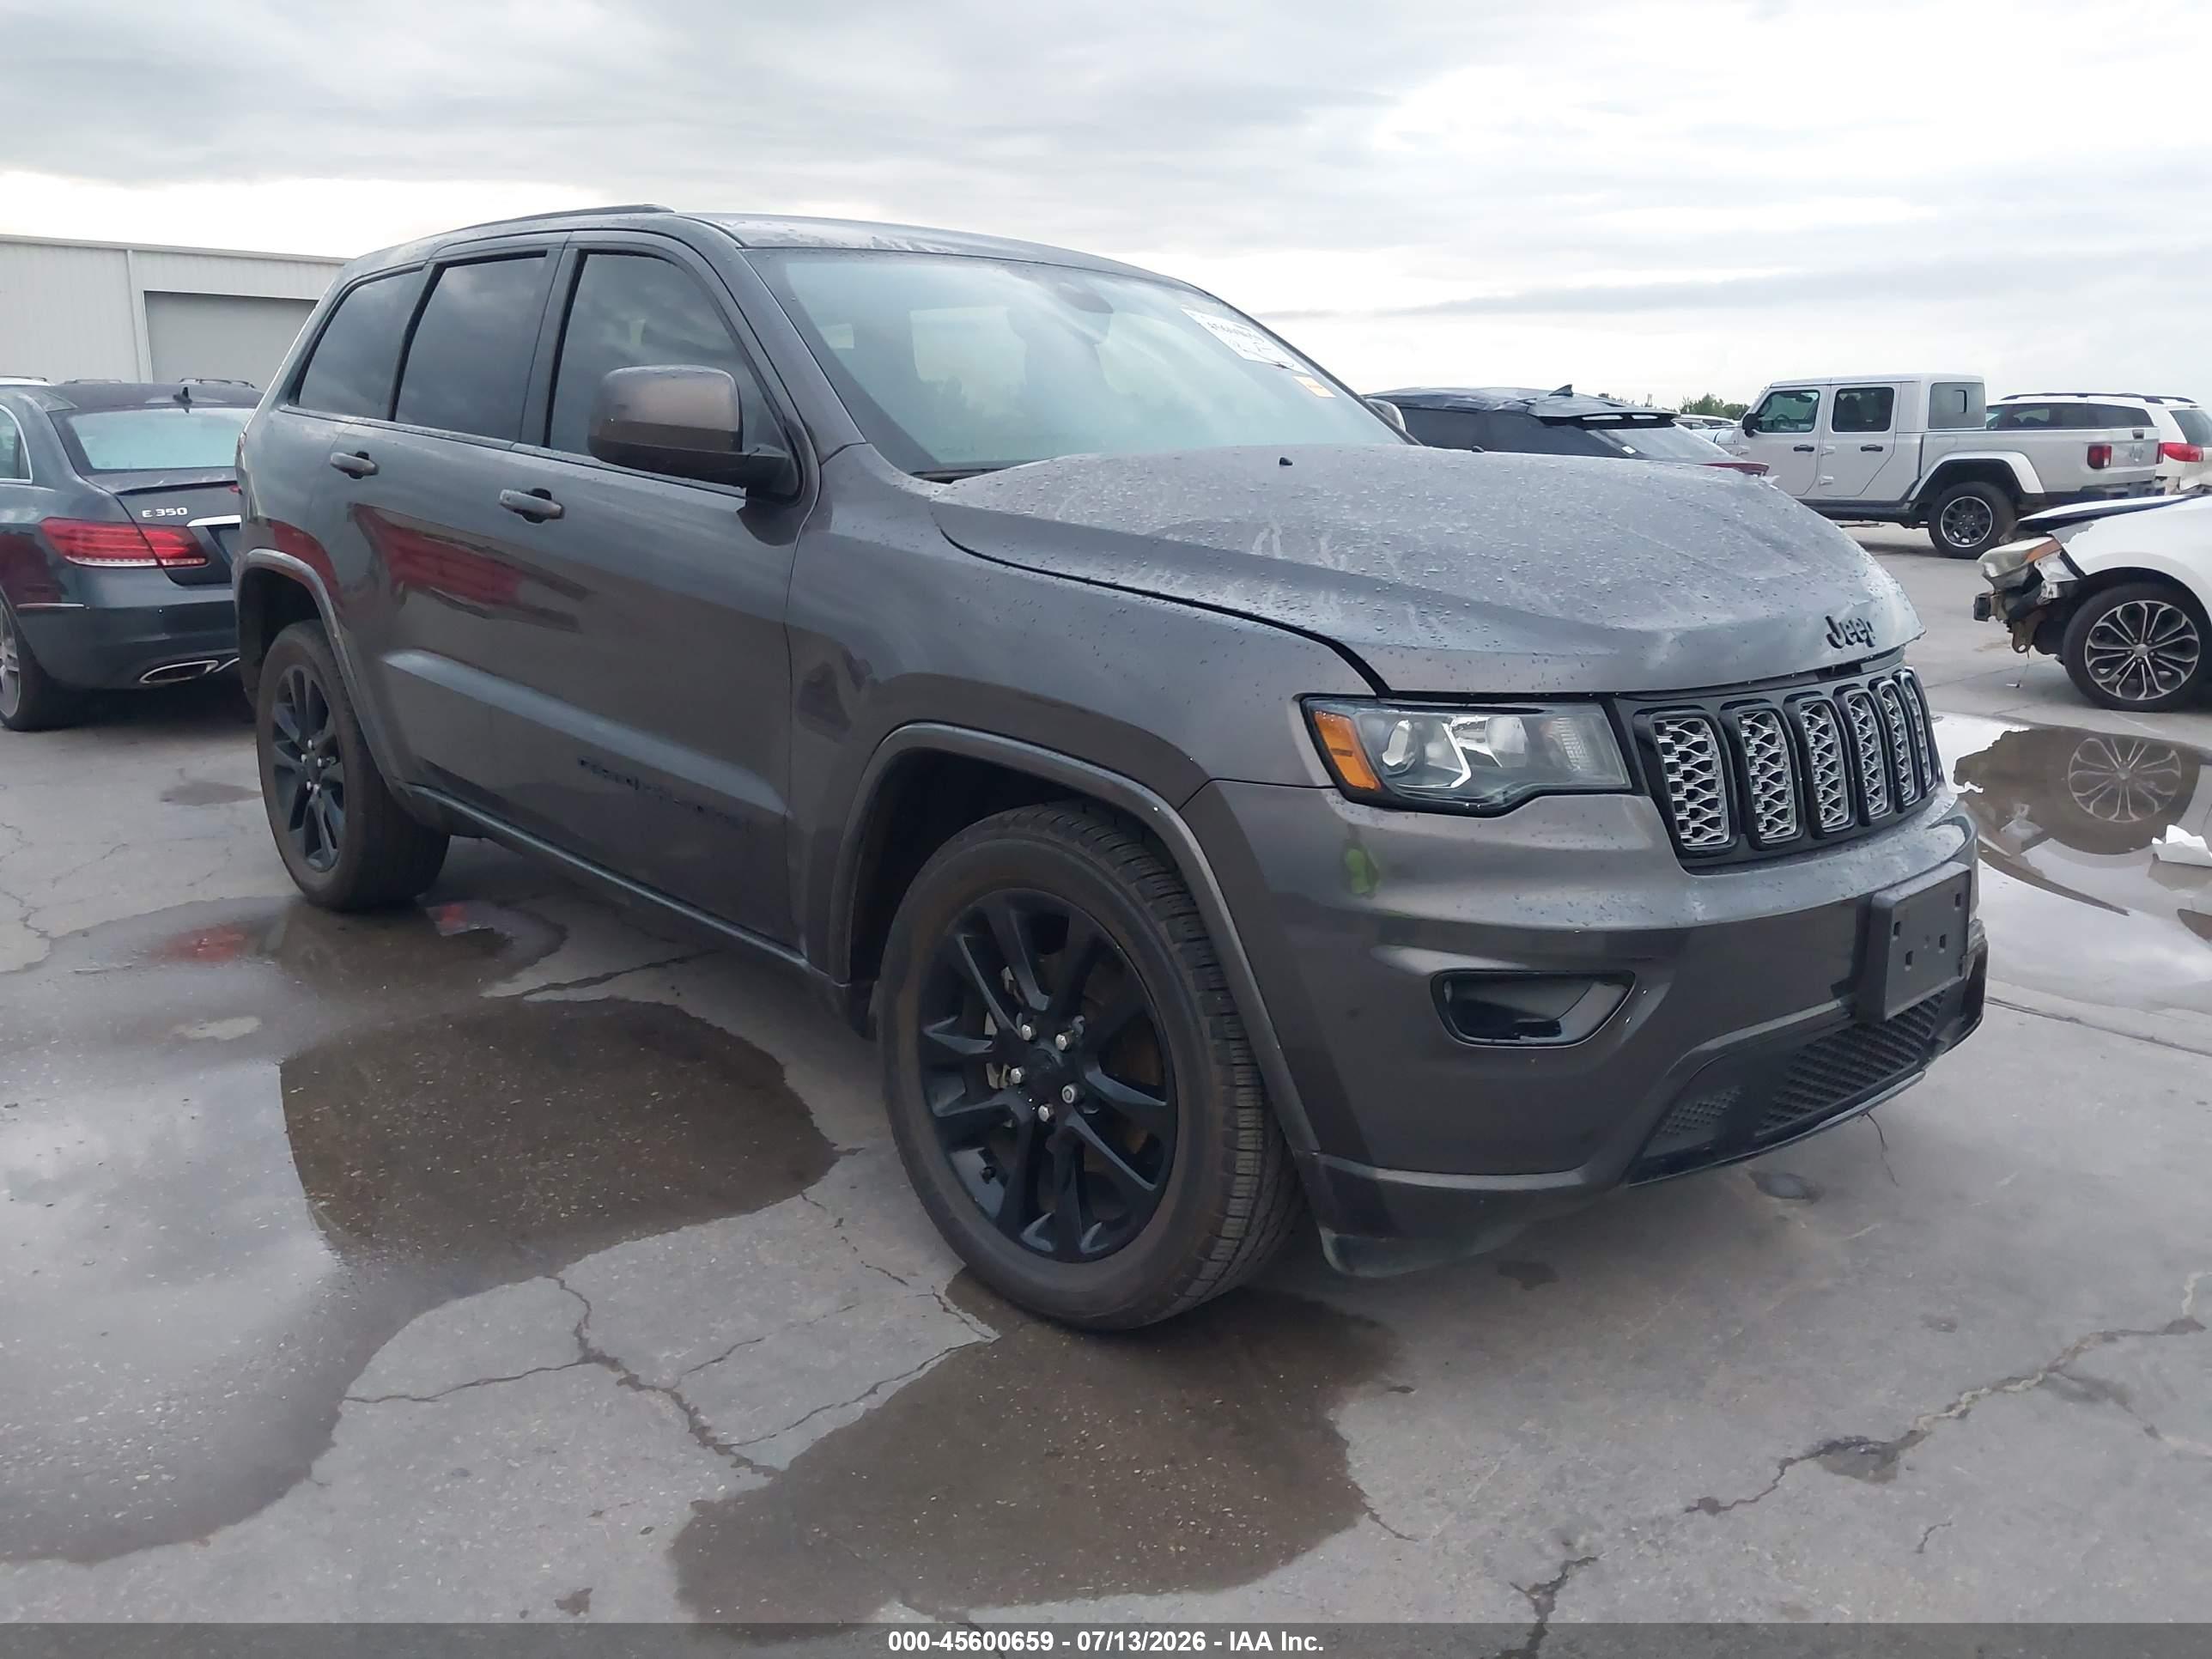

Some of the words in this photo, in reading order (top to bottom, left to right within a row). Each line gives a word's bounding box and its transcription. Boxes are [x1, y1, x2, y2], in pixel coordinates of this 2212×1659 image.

[143, 509, 153, 518] E
[155, 507, 188, 517] 350
[1825, 616, 1876, 649] Jeep
